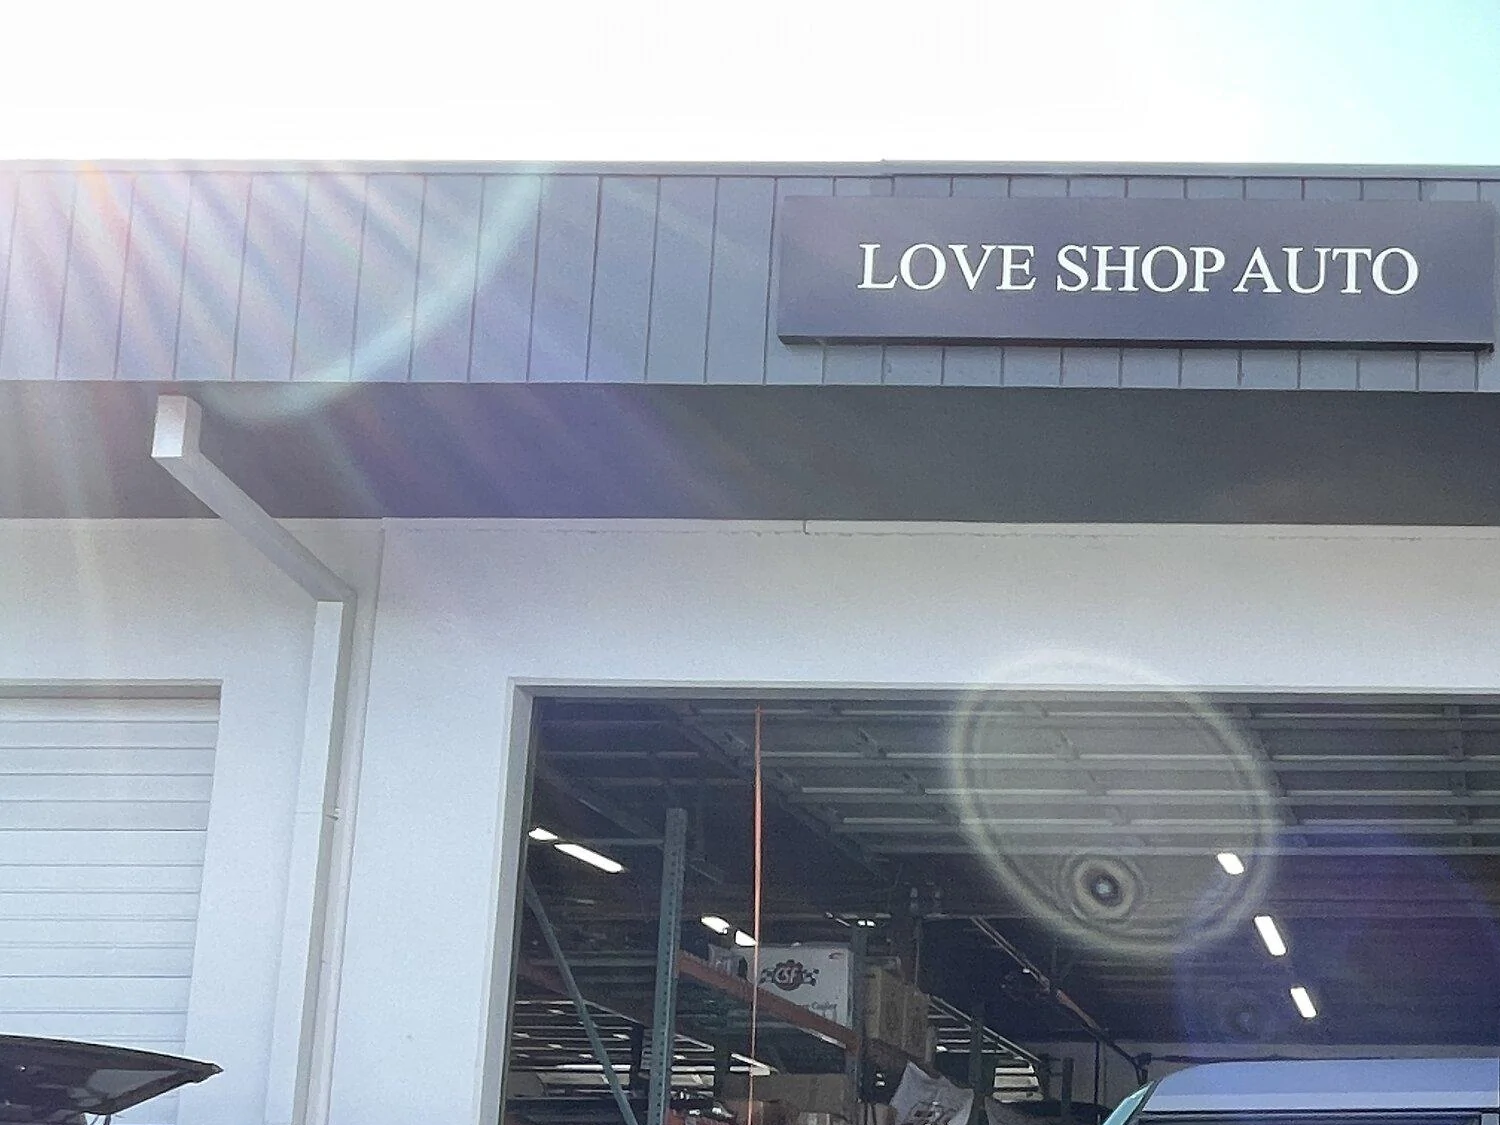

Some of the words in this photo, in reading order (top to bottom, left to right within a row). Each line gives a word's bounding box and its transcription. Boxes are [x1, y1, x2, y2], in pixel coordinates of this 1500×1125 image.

[857, 242, 1038, 292] LOVE
[1055, 244, 1226, 294] SHOP
[1233, 246, 1420, 296] AUTO
